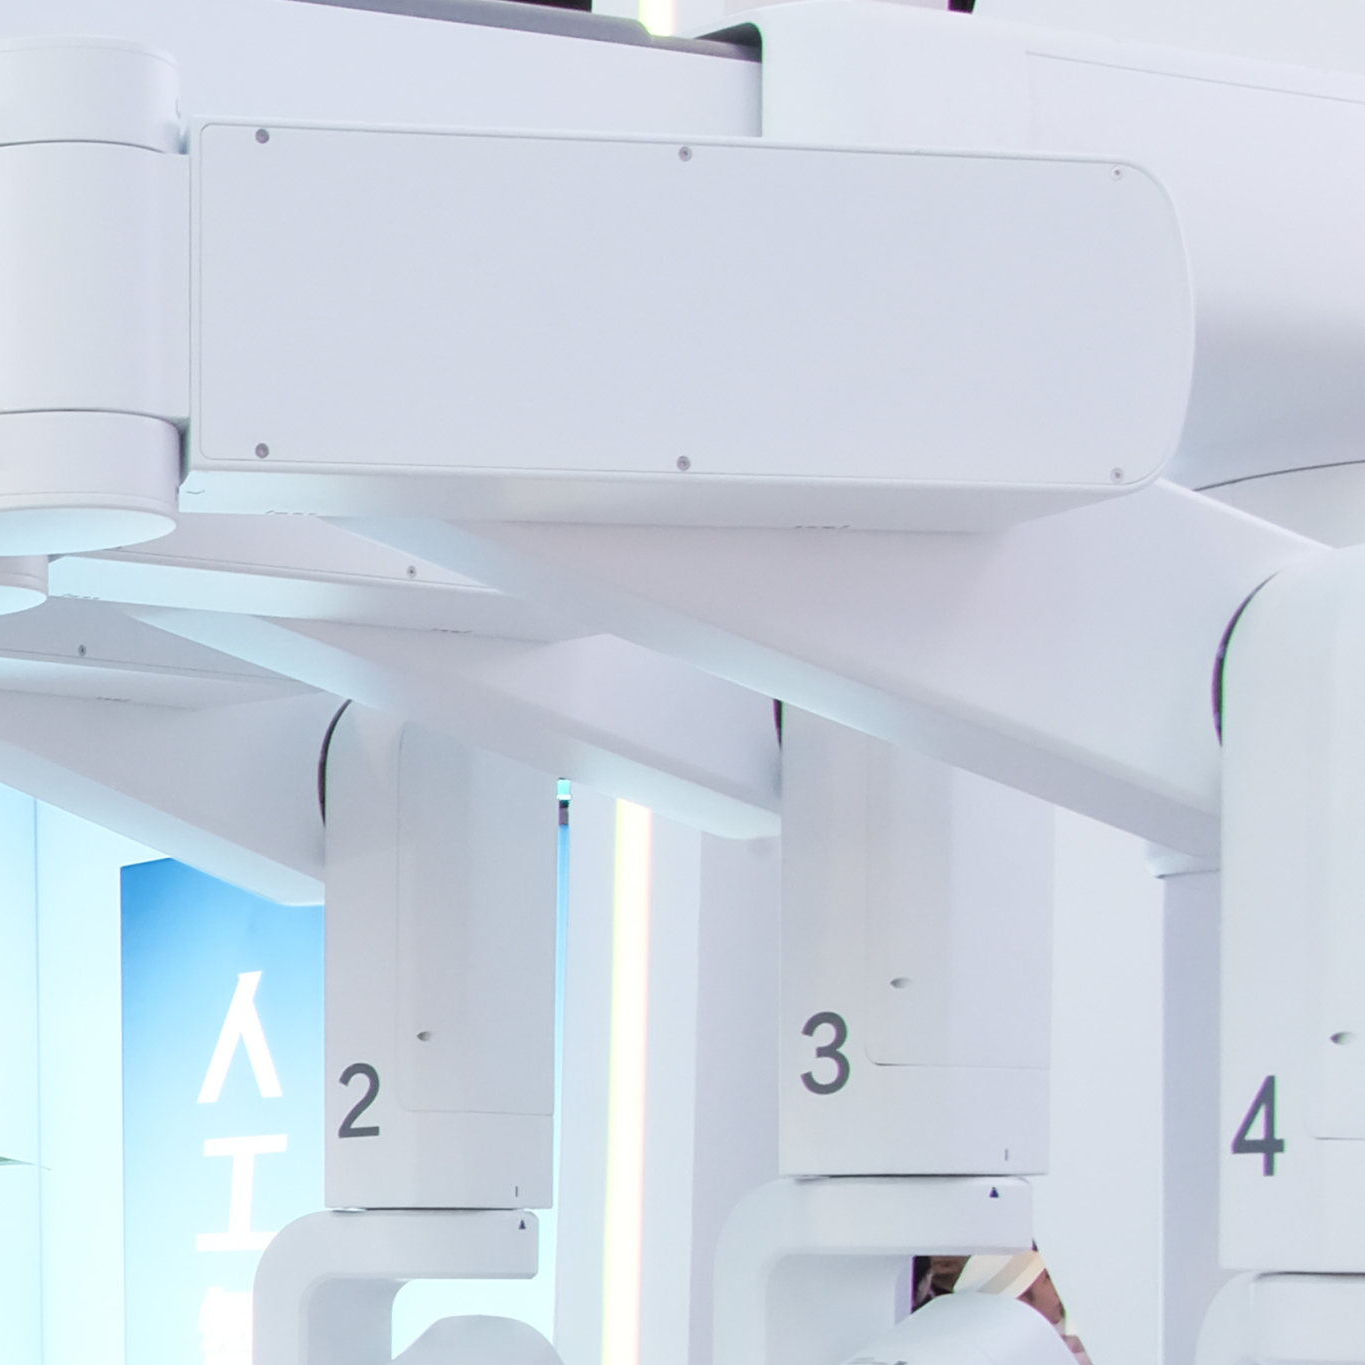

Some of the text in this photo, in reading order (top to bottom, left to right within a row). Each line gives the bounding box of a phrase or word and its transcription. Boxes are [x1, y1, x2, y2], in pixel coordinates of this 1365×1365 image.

[800, 1010, 851, 1096] 3
[337, 1061, 381, 1139] 2
[1231, 1074, 1286, 1177] 4
